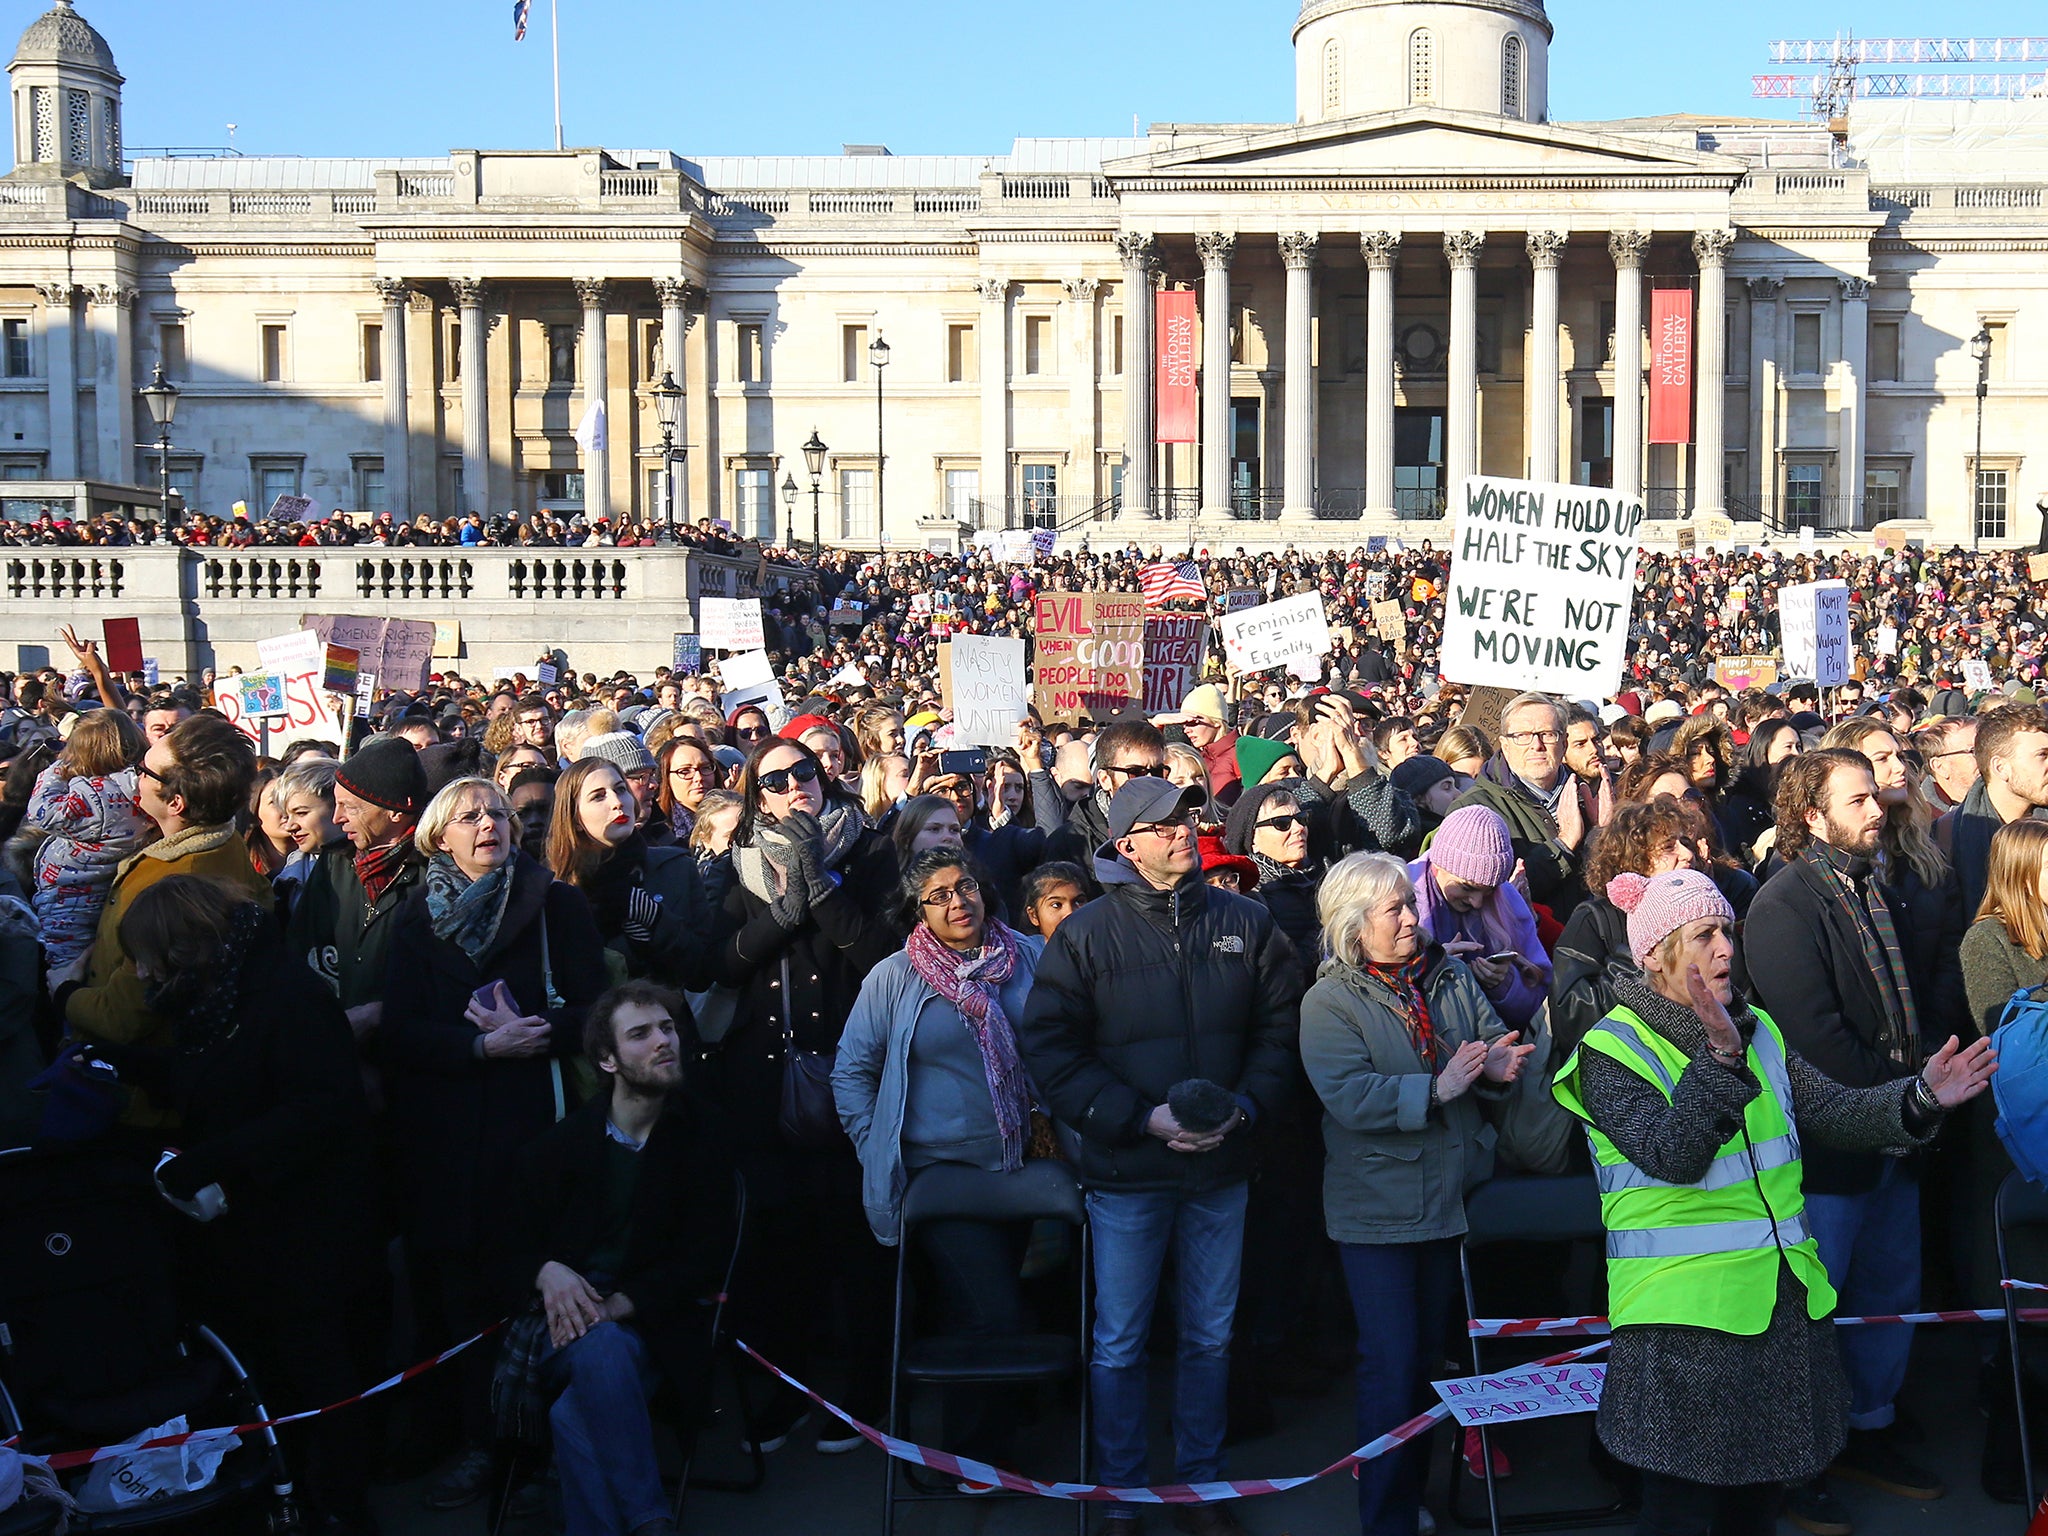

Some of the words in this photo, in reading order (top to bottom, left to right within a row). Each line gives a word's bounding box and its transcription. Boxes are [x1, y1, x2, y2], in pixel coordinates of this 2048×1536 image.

[1250, 195, 1301, 209] THE
[1320, 195, 1456, 209] NATIONAL
[1475, 194, 1598, 209] GALLERY
[1168, 315, 1178, 386] NATIONAL
[1179, 316, 1191, 387] GALLERY
[1662, 313, 1674, 385] NATIONAL
[1673, 314, 1687, 386] GALLERY
[1466, 483, 1545, 527] WOMEN
[1554, 498, 1611, 534] HOLD
[1614, 499, 1644, 538] UP
[1462, 527, 1528, 564] HALF
[1533, 540, 1573, 571] THE
[1576, 539, 1634, 581] SKY
[1457, 585, 1539, 627] WE'RE
[1565, 597, 1623, 634] NOT
[1816, 591, 1842, 610] TRUMP
[1036, 598, 1092, 635] EVIL
[1095, 603, 1142, 620] SUCCEEDS
[1144, 613, 1204, 638] FIGHT
[1235, 607, 1318, 640] Feminism
[260, 642, 282, 653] What
[385, 627, 431, 642] RIGHTS
[1816, 634, 1846, 657] Vulgar
[375, 647, 406, 659] SAME
[410, 650, 428, 662] AS
[955, 643, 1013, 684] NASTY
[1039, 640, 1073, 652] WHEN
[1076, 638, 1144, 669] GOOD
[1144, 639, 1184, 664] LIKE
[1184, 640, 1199, 665] A
[1250, 640, 1313, 665] Equality
[1474, 629, 1601, 671] MOVING
[1718, 658, 1748, 669] MIND
[1752, 658, 1775, 668] YOUR
[1039, 667, 1099, 685] PEOPLE
[1106, 672, 1127, 687] DO
[1728, 668, 1751, 676] OWN
[957, 680, 1024, 703] WOMEN
[1054, 689, 1129, 709] NOTHING
[957, 706, 1021, 737] UNITE
[1446, 1368, 1571, 1397] NASTY
[1465, 1399, 1541, 1423] BAD
[111, 1460, 151, 1498] John
